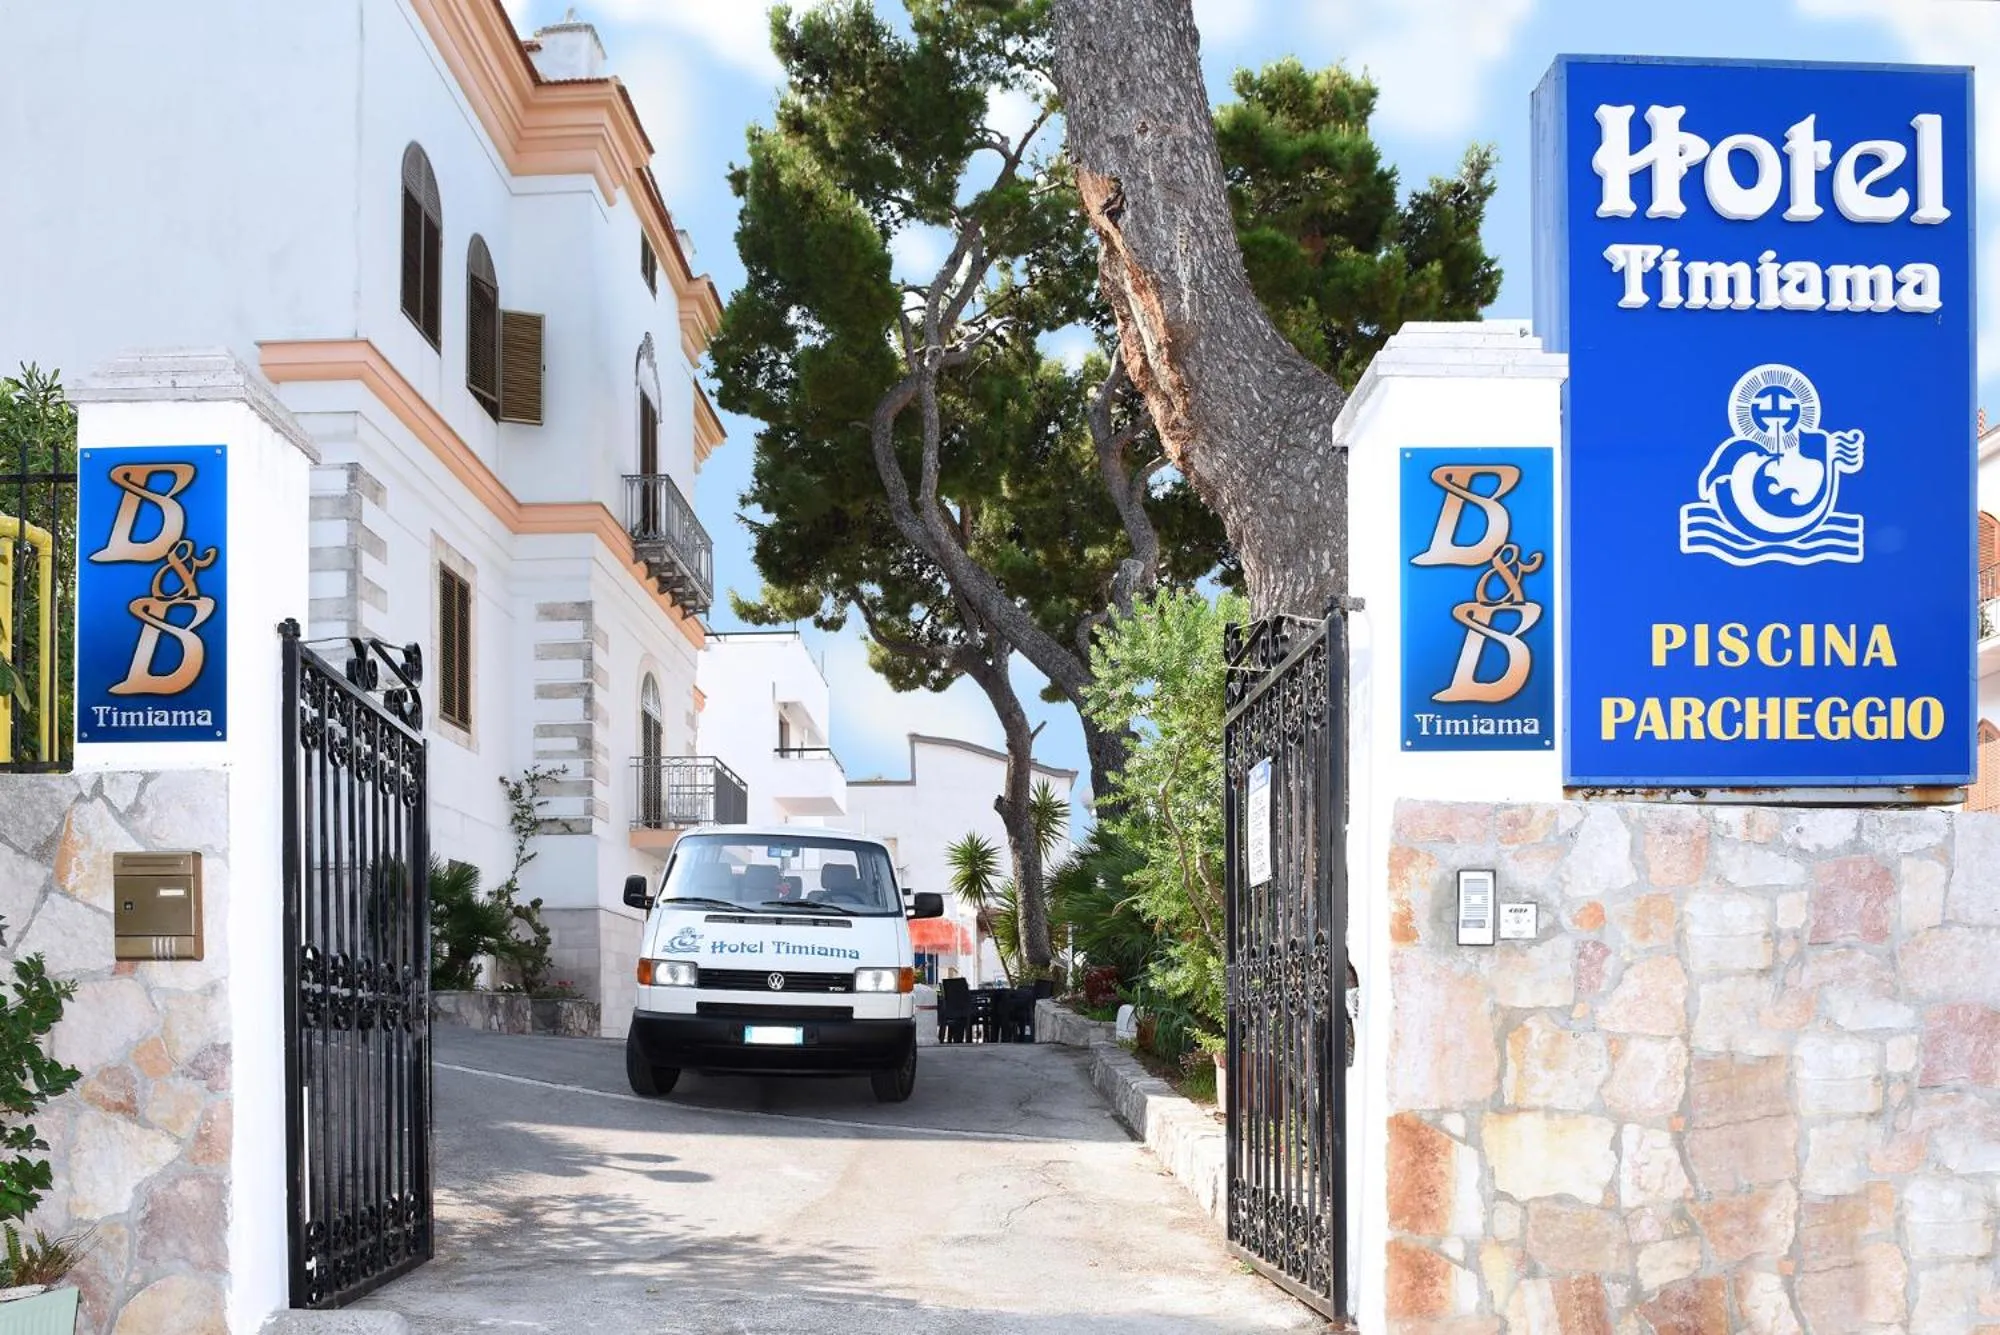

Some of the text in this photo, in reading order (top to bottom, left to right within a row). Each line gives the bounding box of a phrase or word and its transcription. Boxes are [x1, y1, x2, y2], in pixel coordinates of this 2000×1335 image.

[1591, 103, 1952, 225] Hotel
[1602, 243, 1942, 313] Timiama
[1651, 623, 1898, 668] PISCINA
[91, 705, 213, 728] Timiama
[1413, 713, 1540, 736] Timiama
[1600, 696, 1945, 741] PARCHEGGIO
[711, 940, 860, 960] Hotel Timiama
